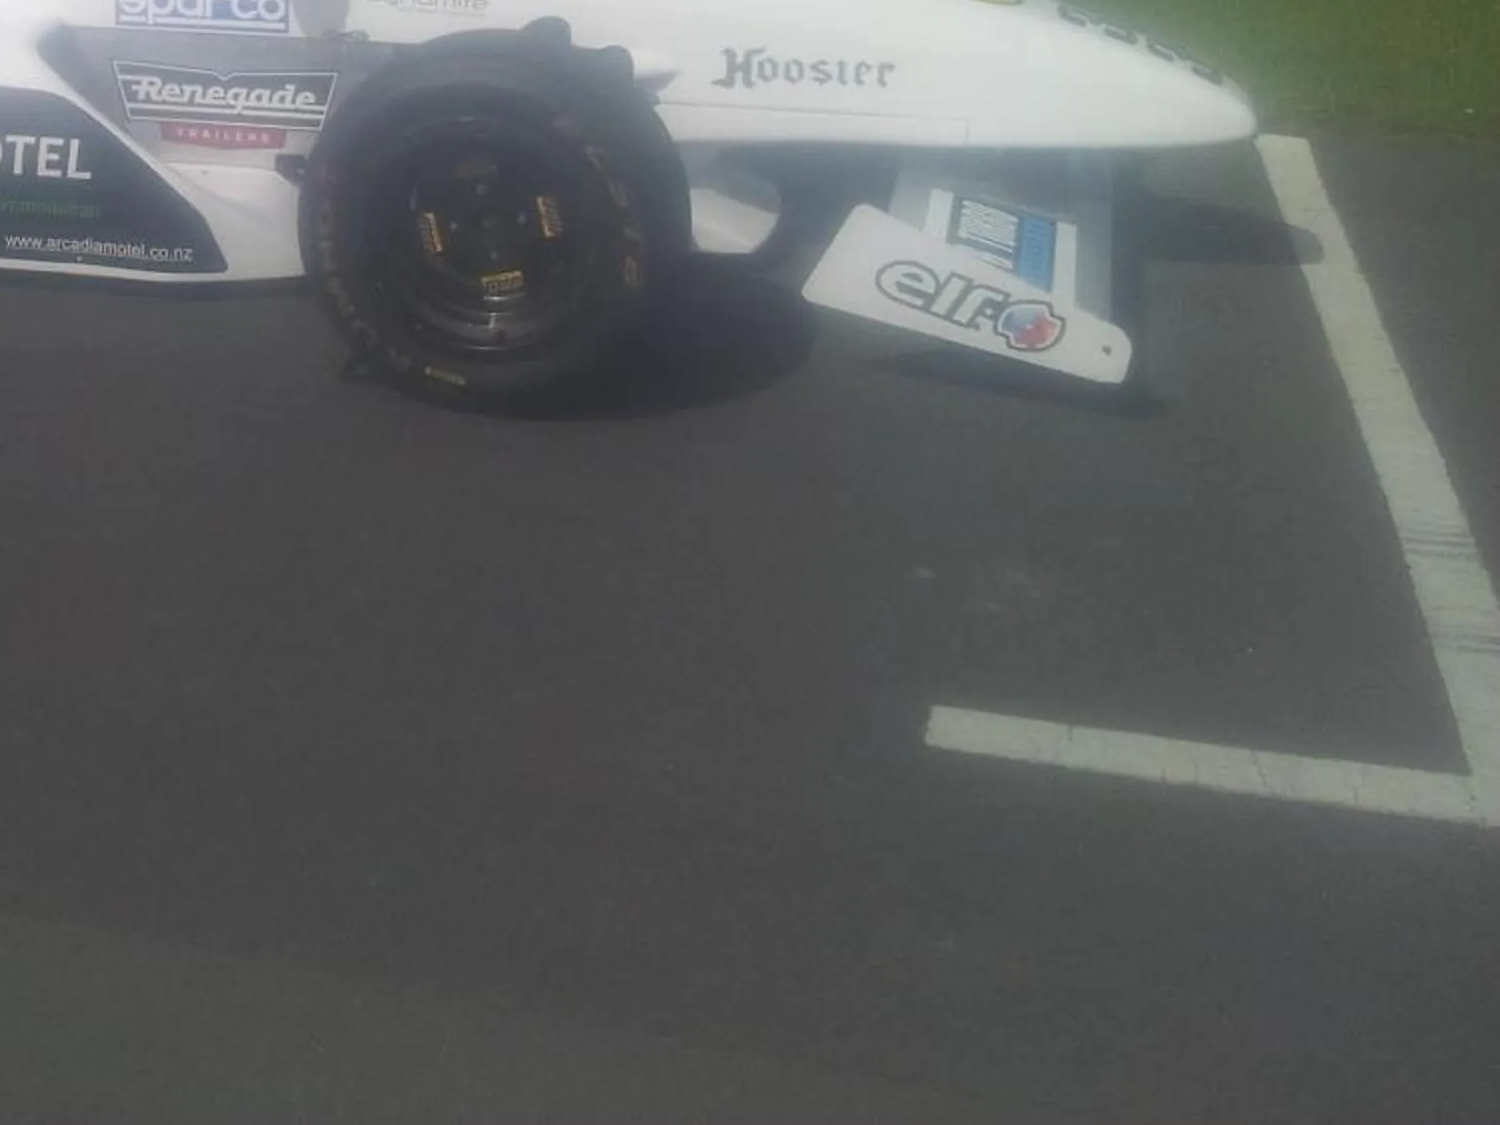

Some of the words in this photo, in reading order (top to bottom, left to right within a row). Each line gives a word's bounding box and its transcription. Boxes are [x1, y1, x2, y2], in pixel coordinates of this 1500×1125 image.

[711, 46, 896, 89] Hoosier
[131, 74, 318, 116] Renegade
[4, 232, 194, 263] www.arcadiamotel.co.nz
